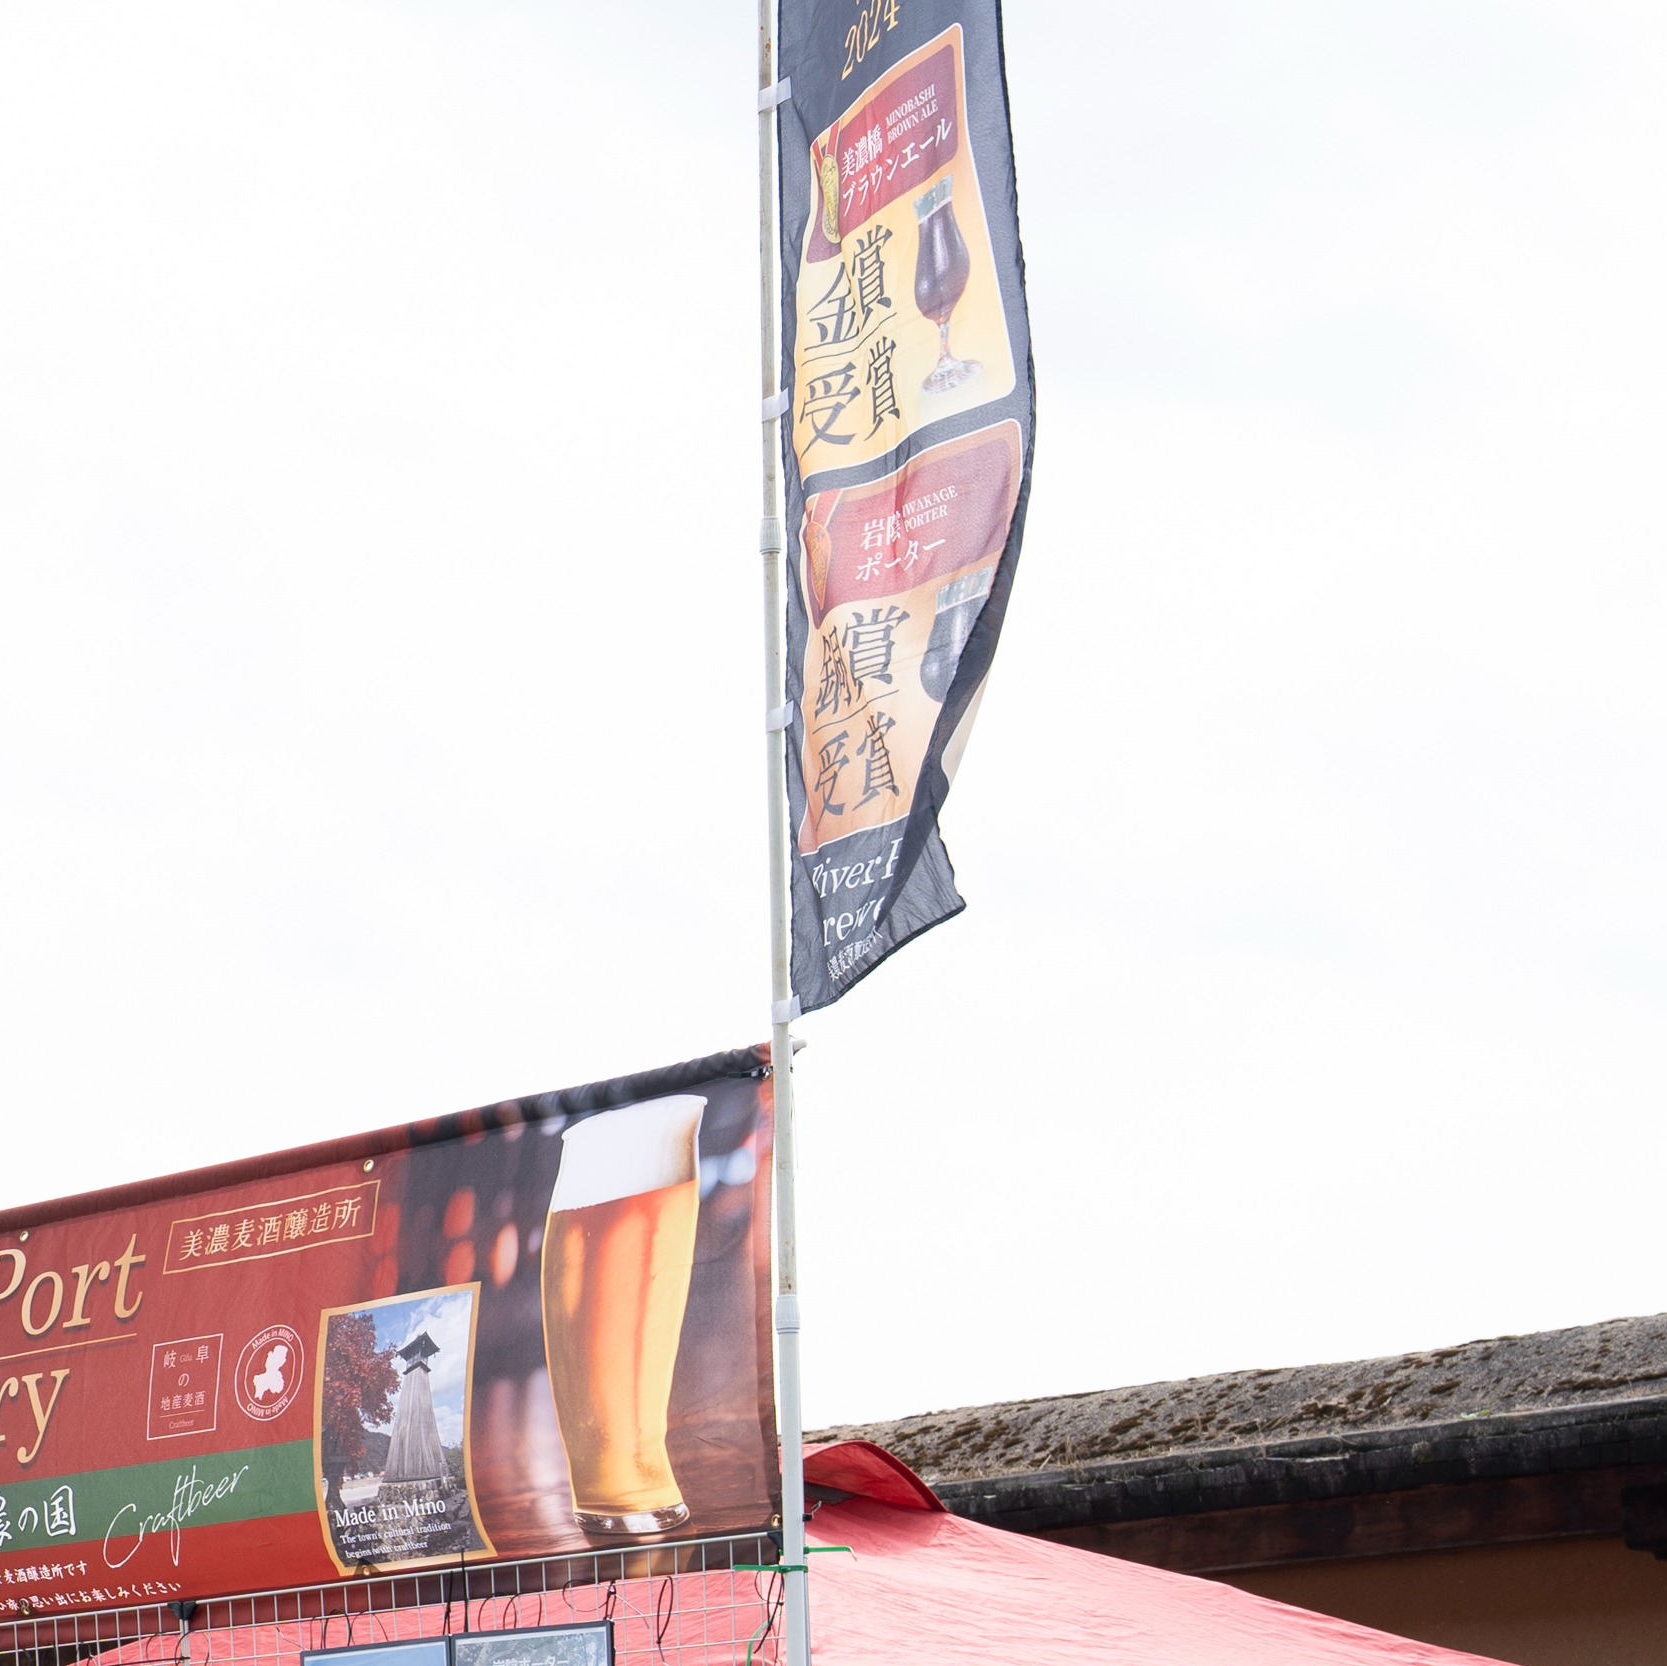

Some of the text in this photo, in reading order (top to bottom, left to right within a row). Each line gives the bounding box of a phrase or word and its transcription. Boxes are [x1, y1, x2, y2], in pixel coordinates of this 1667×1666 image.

[884, 83, 936, 129] MINOBASHI
[886, 98, 939, 144] BROWN ALE
[841, 123, 884, 184] 美濃橋
[842, 117, 953, 217] ブラウンエール
[902, 485, 958, 518] IWAKAGE
[855, 538, 946, 582] ポーター
[178, 1196, 362, 1261] 美濃麦酒醸造所
[334, 1497, 446, 1528] Made in Mino
[340, 1521, 452, 1545] The town's cultural tradition
[345, 1549, 372, 1559] begins
